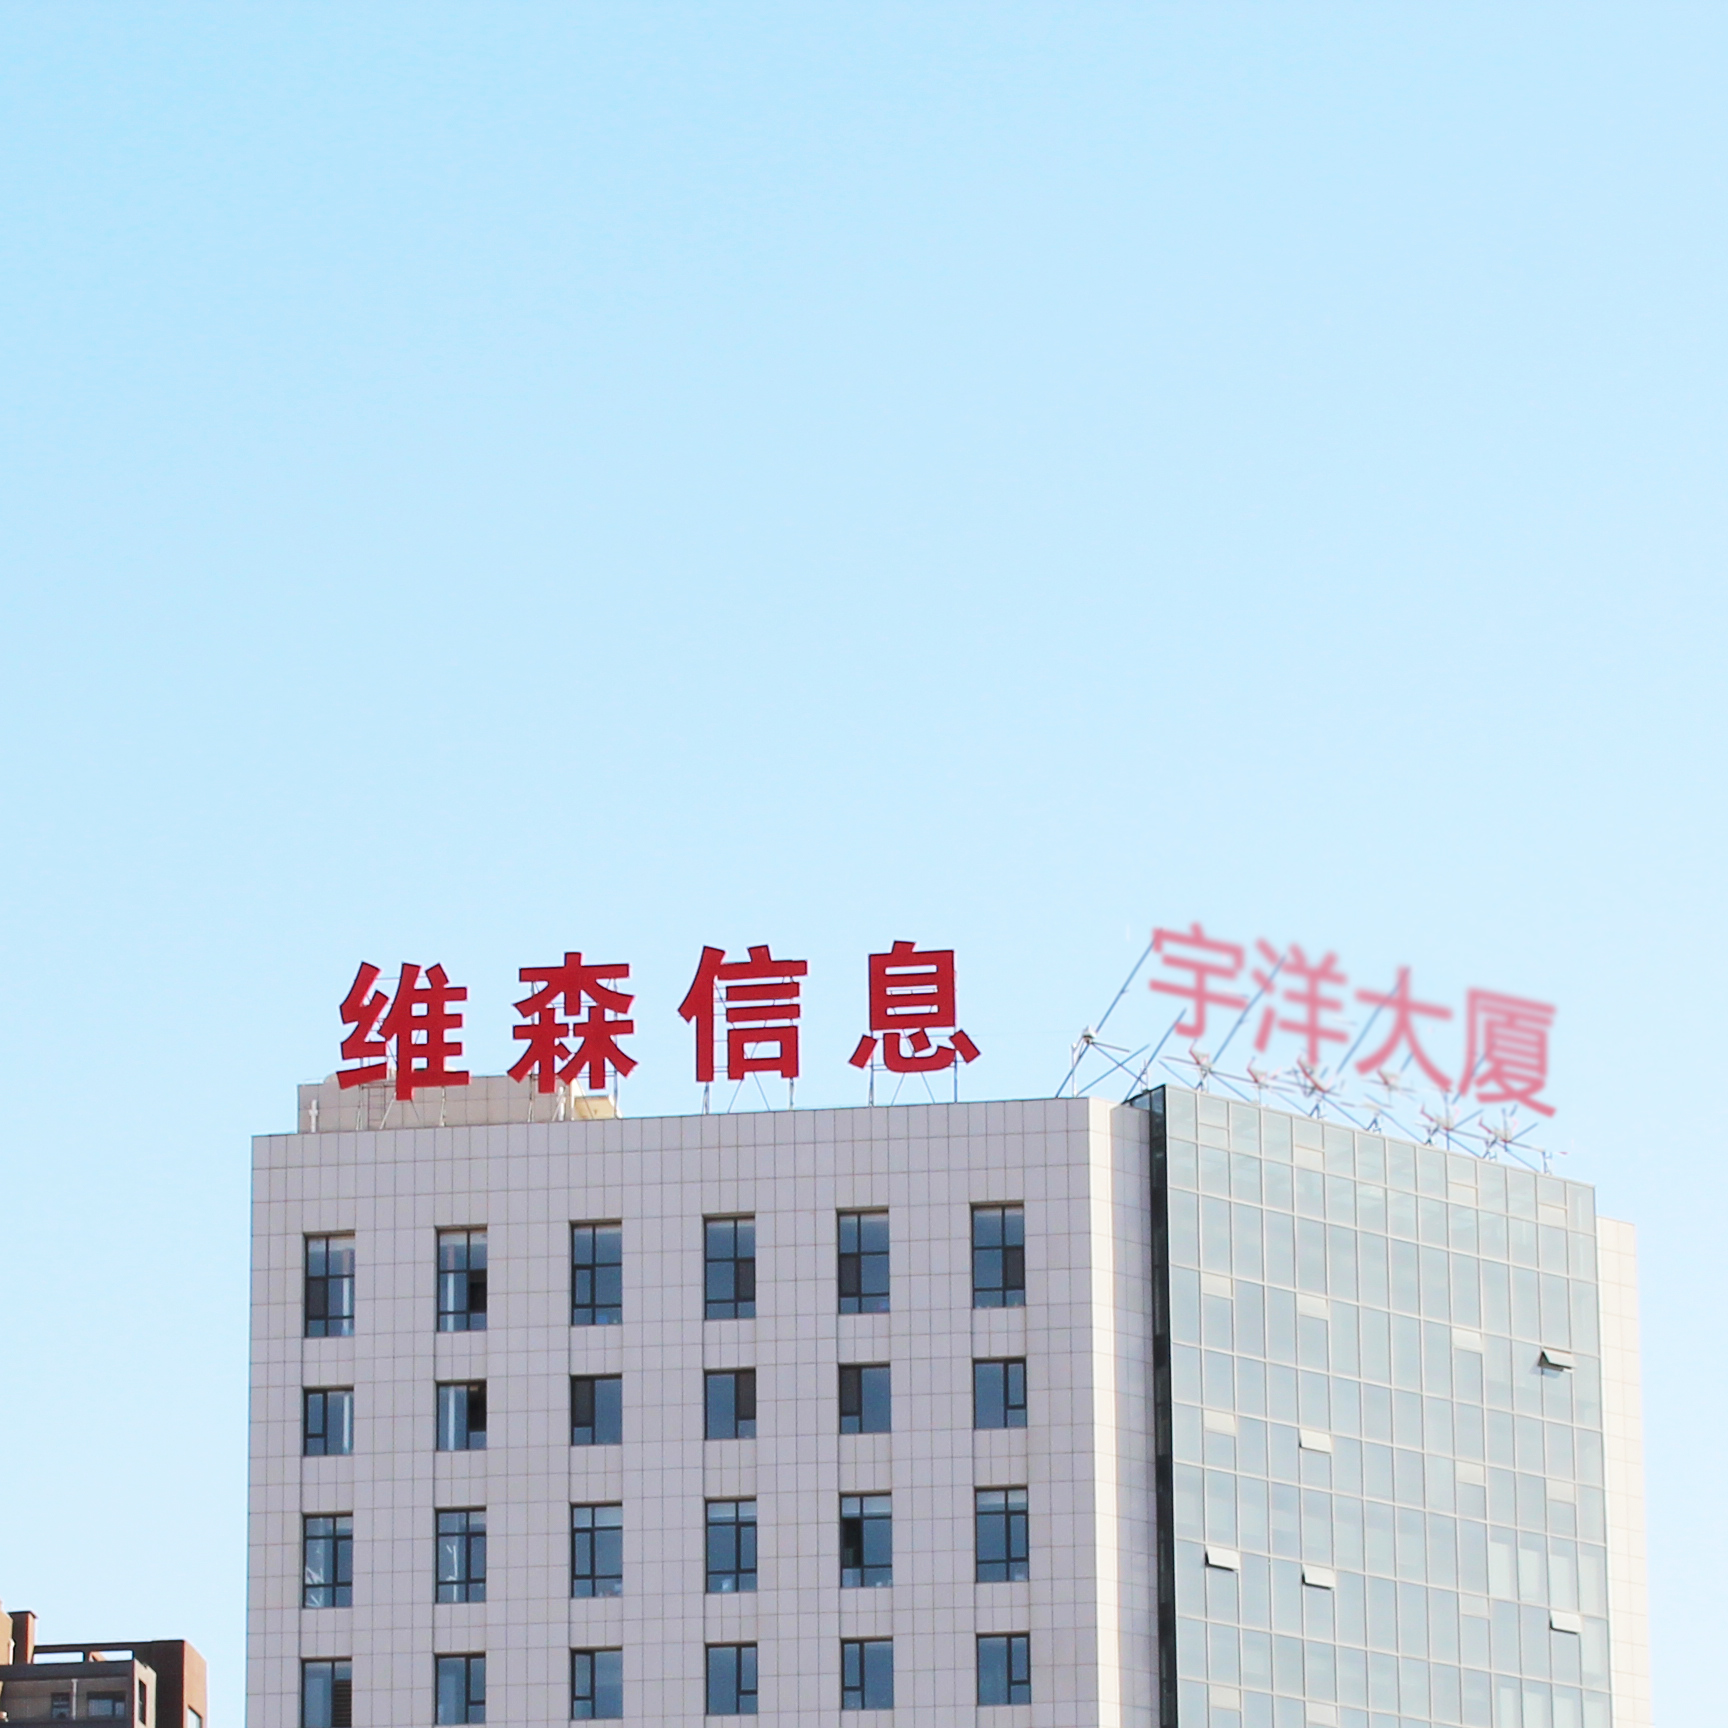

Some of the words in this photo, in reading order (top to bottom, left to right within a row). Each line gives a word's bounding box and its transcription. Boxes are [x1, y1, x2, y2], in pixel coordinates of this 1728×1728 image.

[335, 940, 982, 1101] 维森信息
[1148, 921, 1560, 1118] 宇洋大厦
